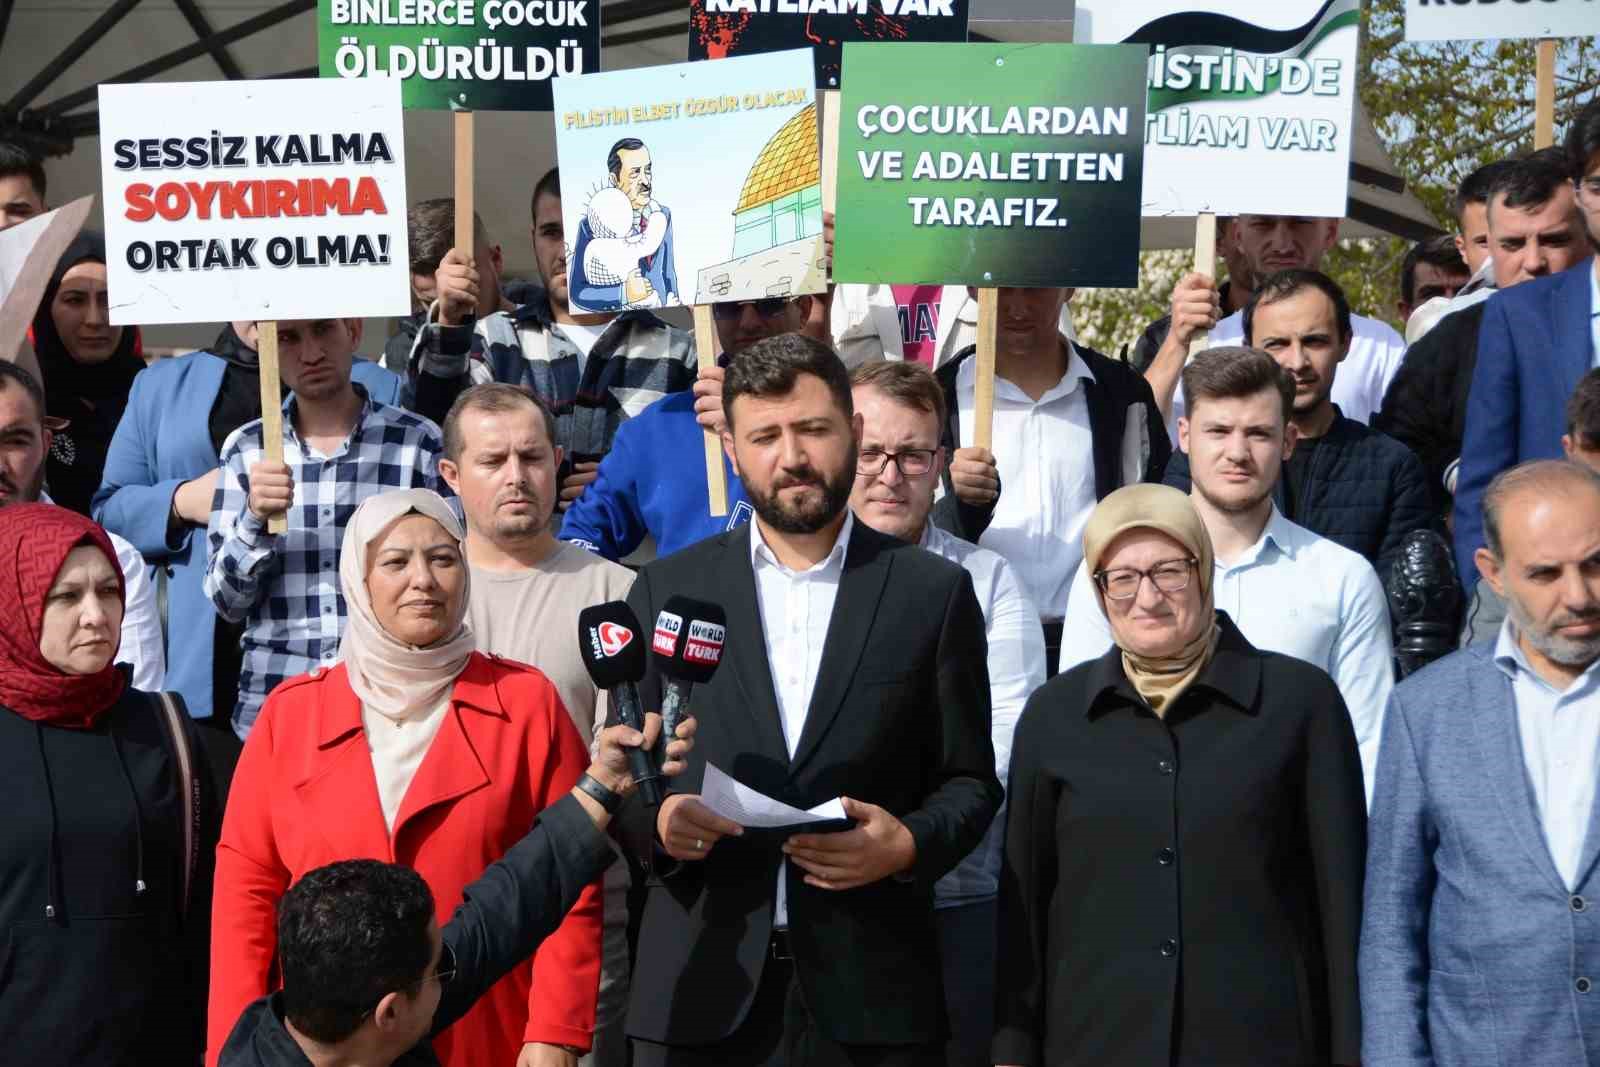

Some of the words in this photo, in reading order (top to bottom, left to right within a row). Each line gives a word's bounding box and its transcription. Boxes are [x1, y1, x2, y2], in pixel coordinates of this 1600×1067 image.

[482, 0, 587, 30] ÇOCUK
[335, 37, 583, 80] ÖLDÜRÜLDÜ
[1147, 44, 1341, 96] İSTİN’DE
[857, 104, 1128, 138] ÇOCUKLARDAN
[1258, 116, 1337, 151] VAR
[114, 130, 247, 169] SESSİZ
[255, 132, 394, 168] KALMA
[856, 151, 903, 179] VE
[912, 151, 1124, 181] ADALETTEN
[124, 176, 387, 222] SOYKIRIMA
[908, 197, 1068, 227] TARAFIZ.
[126, 237, 257, 271] ORTAK
[266, 234, 391, 267] OLMA!
[590, 627, 603, 660] Haber
